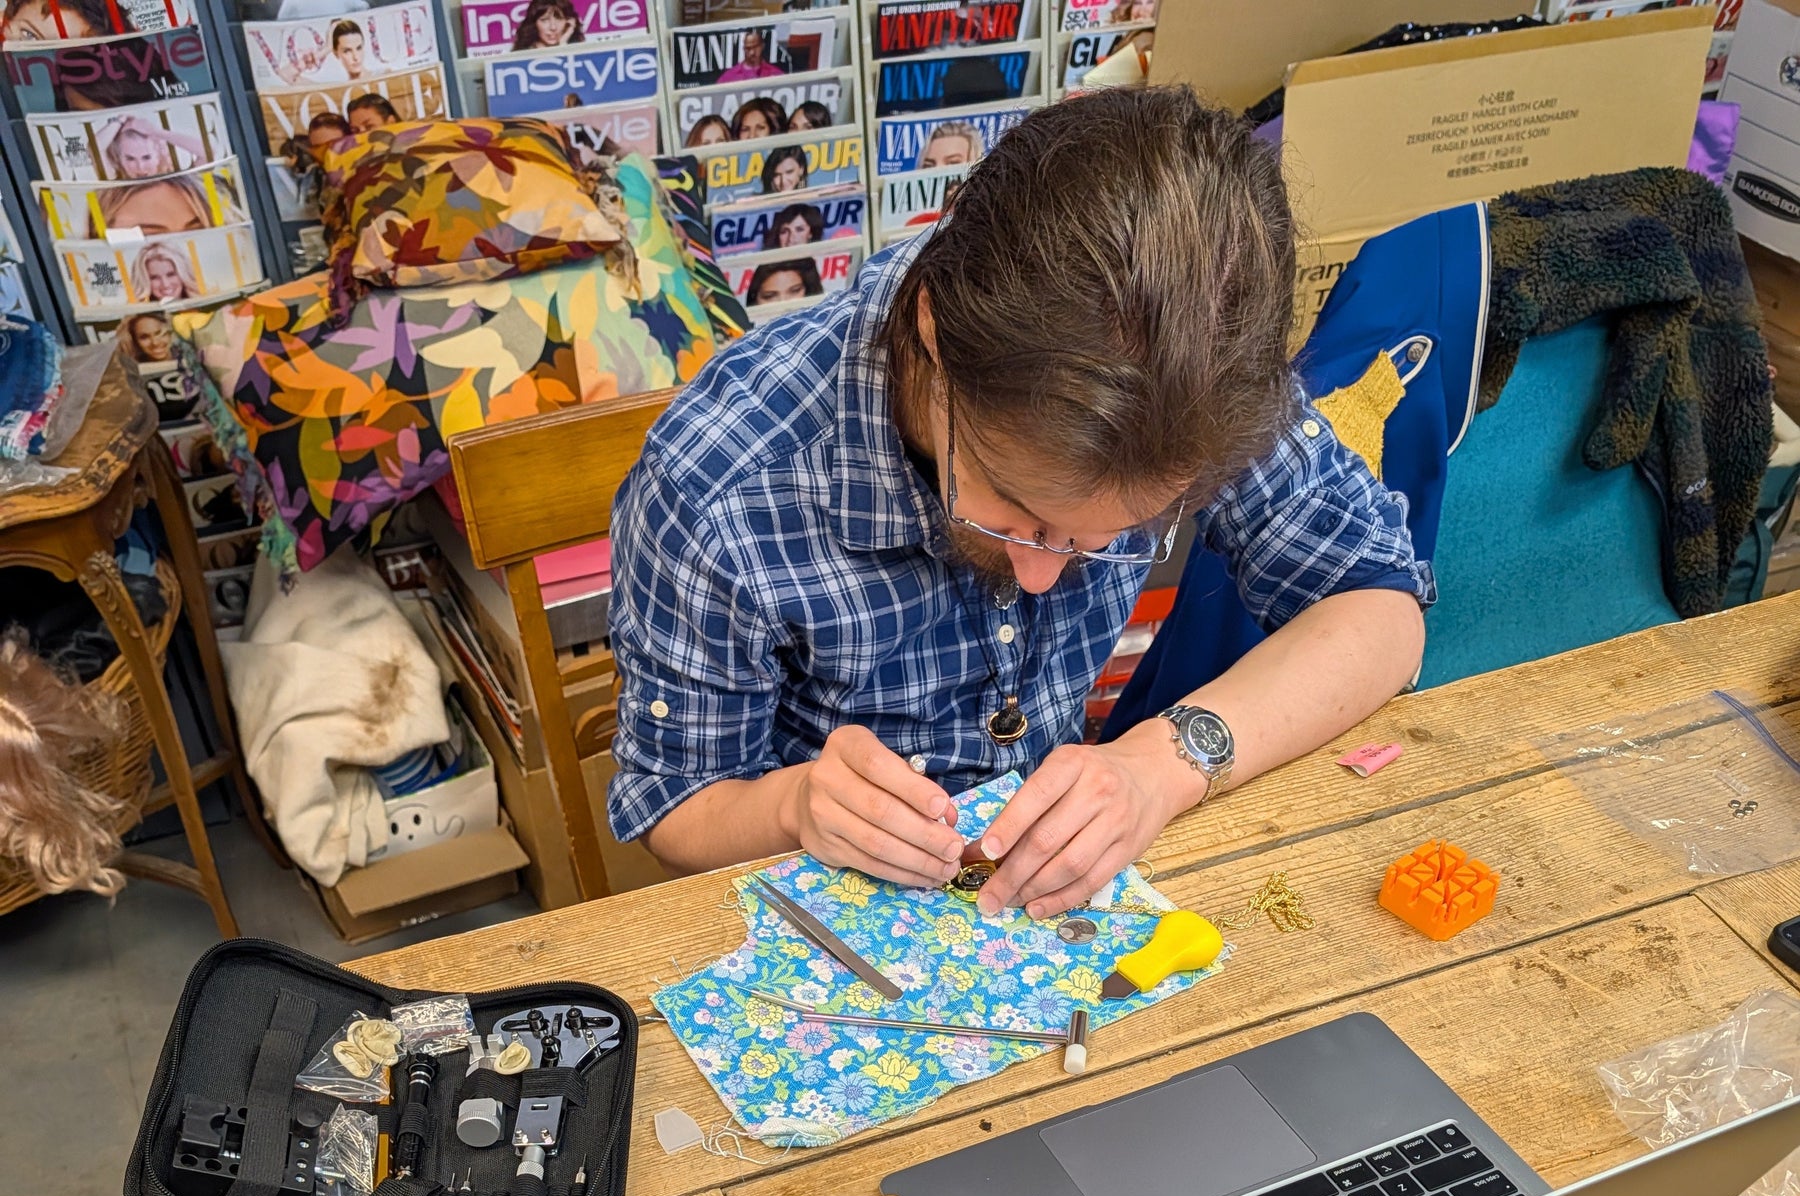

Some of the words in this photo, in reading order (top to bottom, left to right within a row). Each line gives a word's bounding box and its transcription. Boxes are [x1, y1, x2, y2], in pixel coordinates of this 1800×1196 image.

[1066, 10, 1090, 24] SEX
[5, 32, 206, 87] InStyle
[485, 46, 658, 97] InStyle
[1472, 105, 1507, 120] HANDLE
[1509, 101, 1532, 115] WITH
[1403, 1138, 1425, 1150] control
[1372, 1150, 1392, 1161] option
[1462, 1150, 1477, 1159] shift
[1333, 1162, 1362, 1176] command
[1473, 1177, 1486, 1187] lock
[1485, 1173, 1500, 1183] caps
[1397, 1183, 1408, 1192] Z
